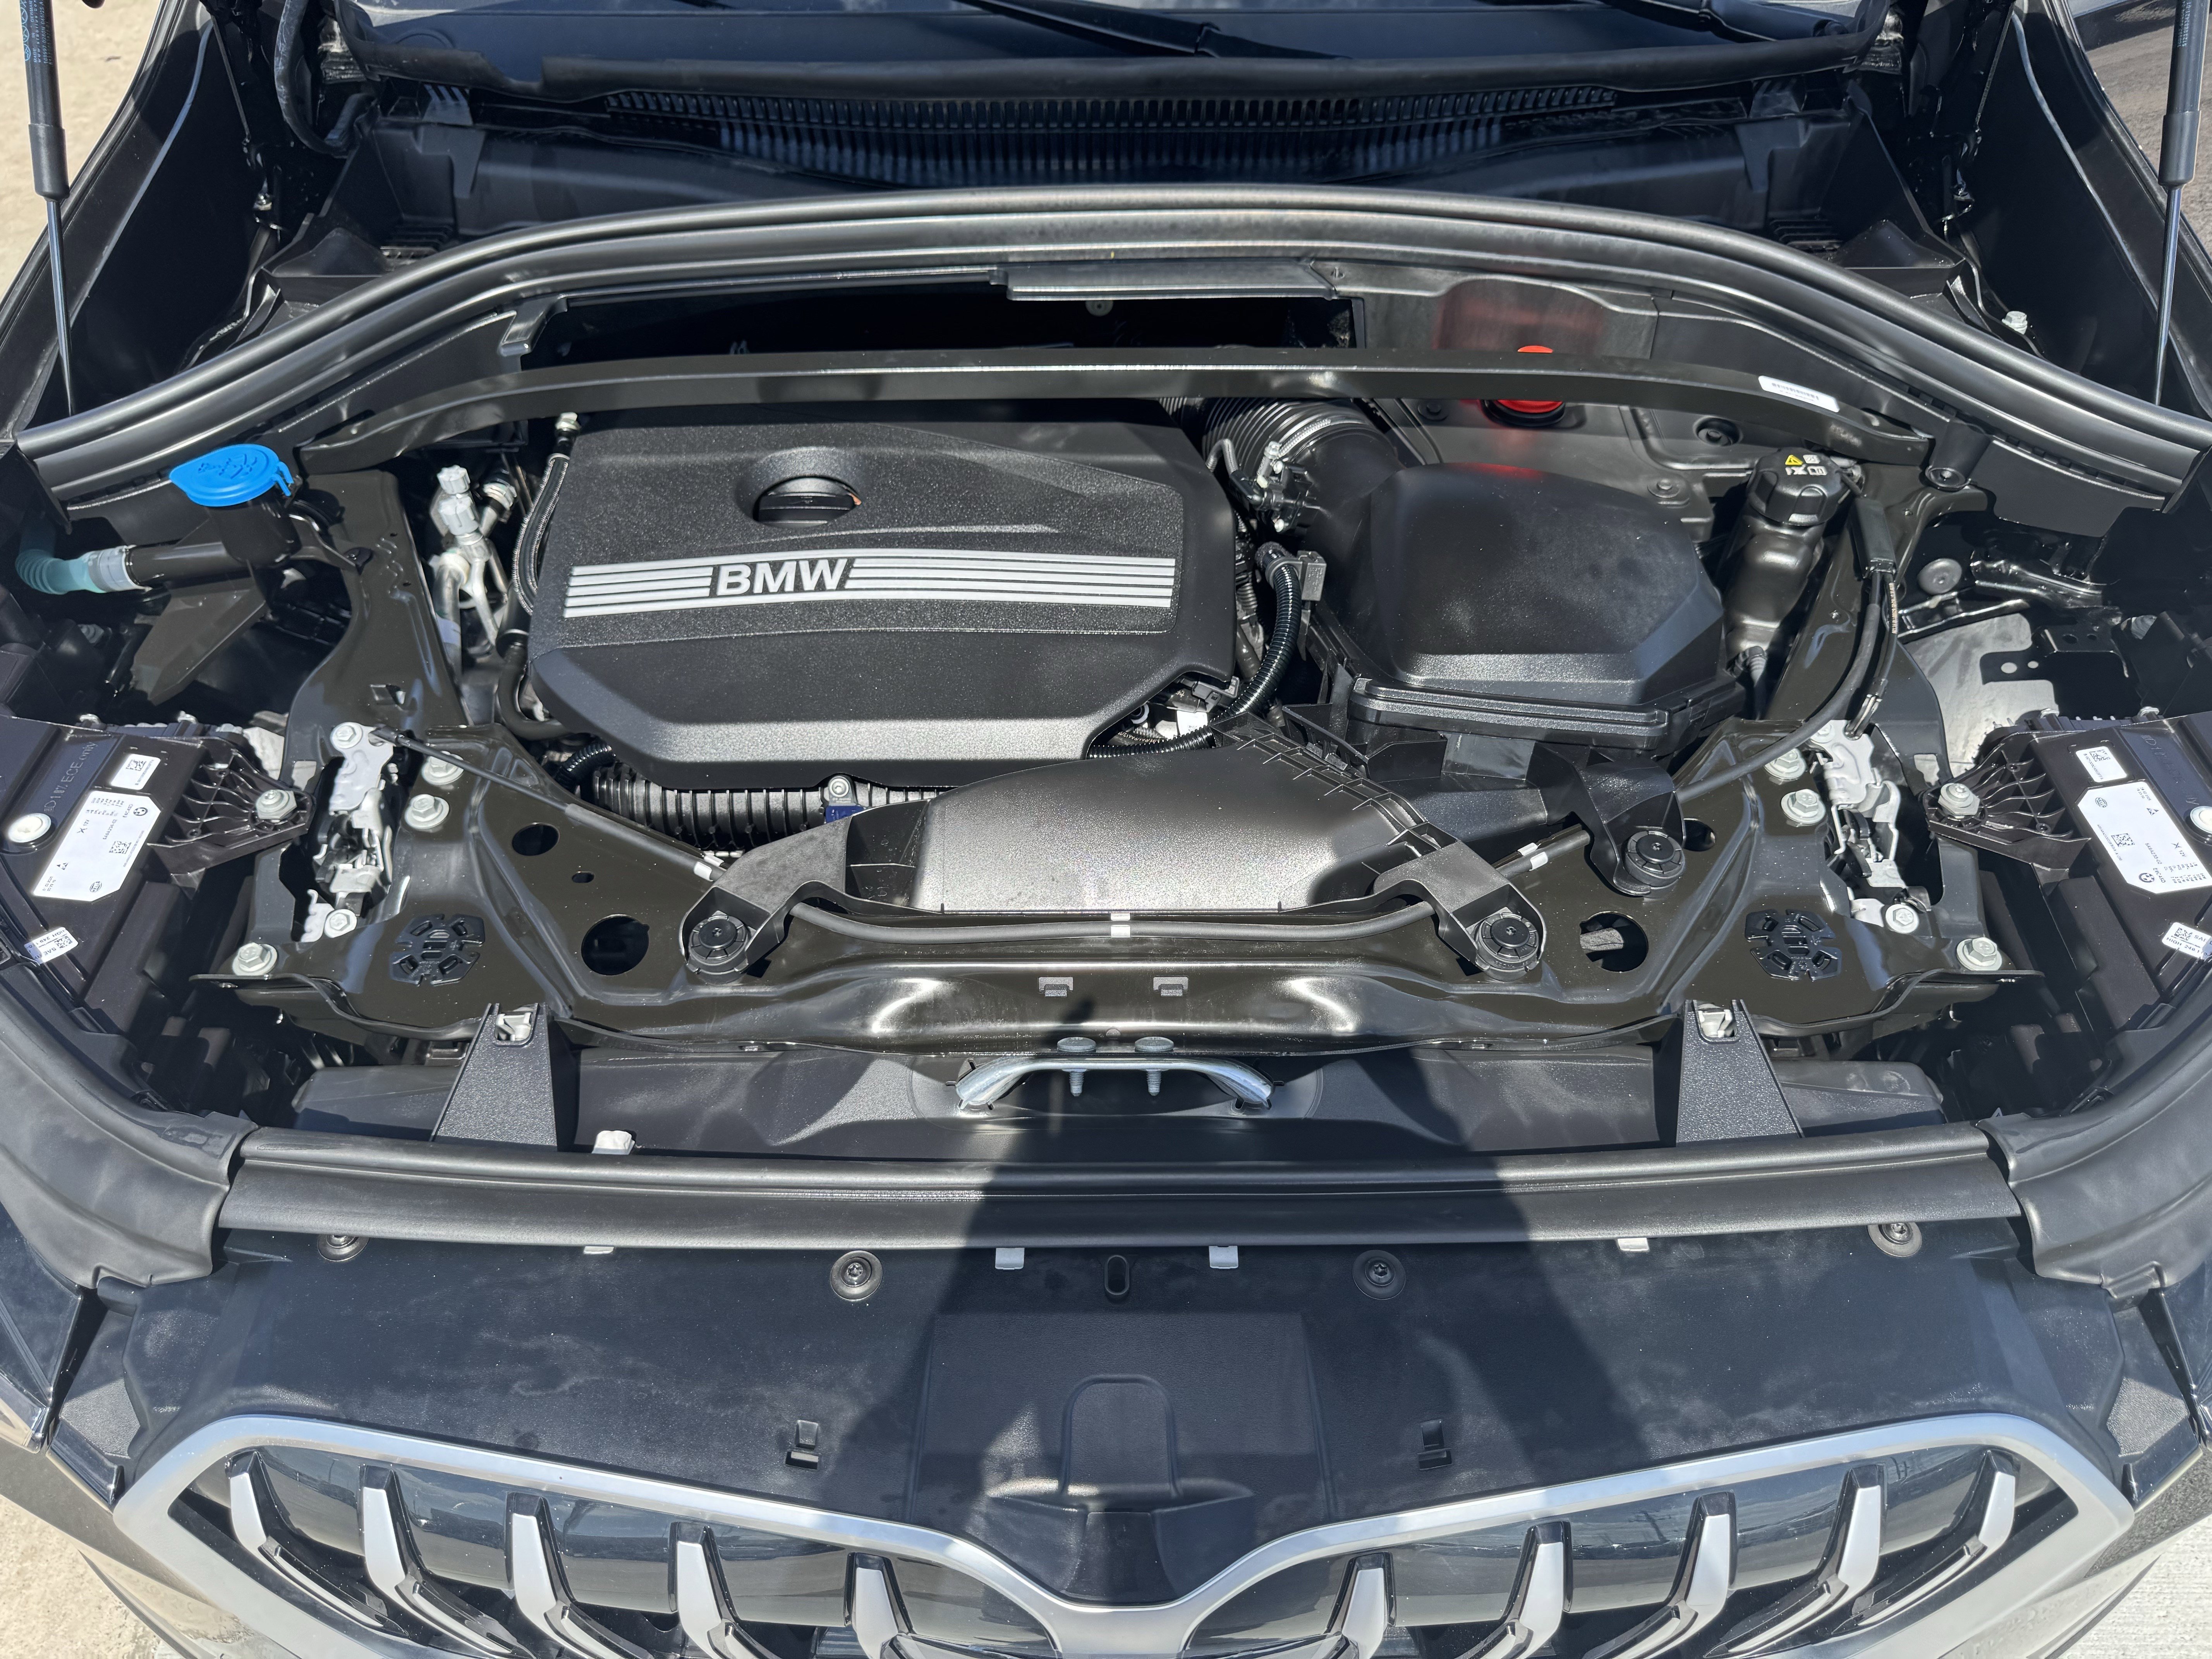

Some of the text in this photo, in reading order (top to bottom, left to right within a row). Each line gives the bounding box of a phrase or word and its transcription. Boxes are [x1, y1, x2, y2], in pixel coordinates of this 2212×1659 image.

[716, 558, 847, 596] BMW
[61, 762, 83, 782] ECE
[79, 742, 98, 760] only
